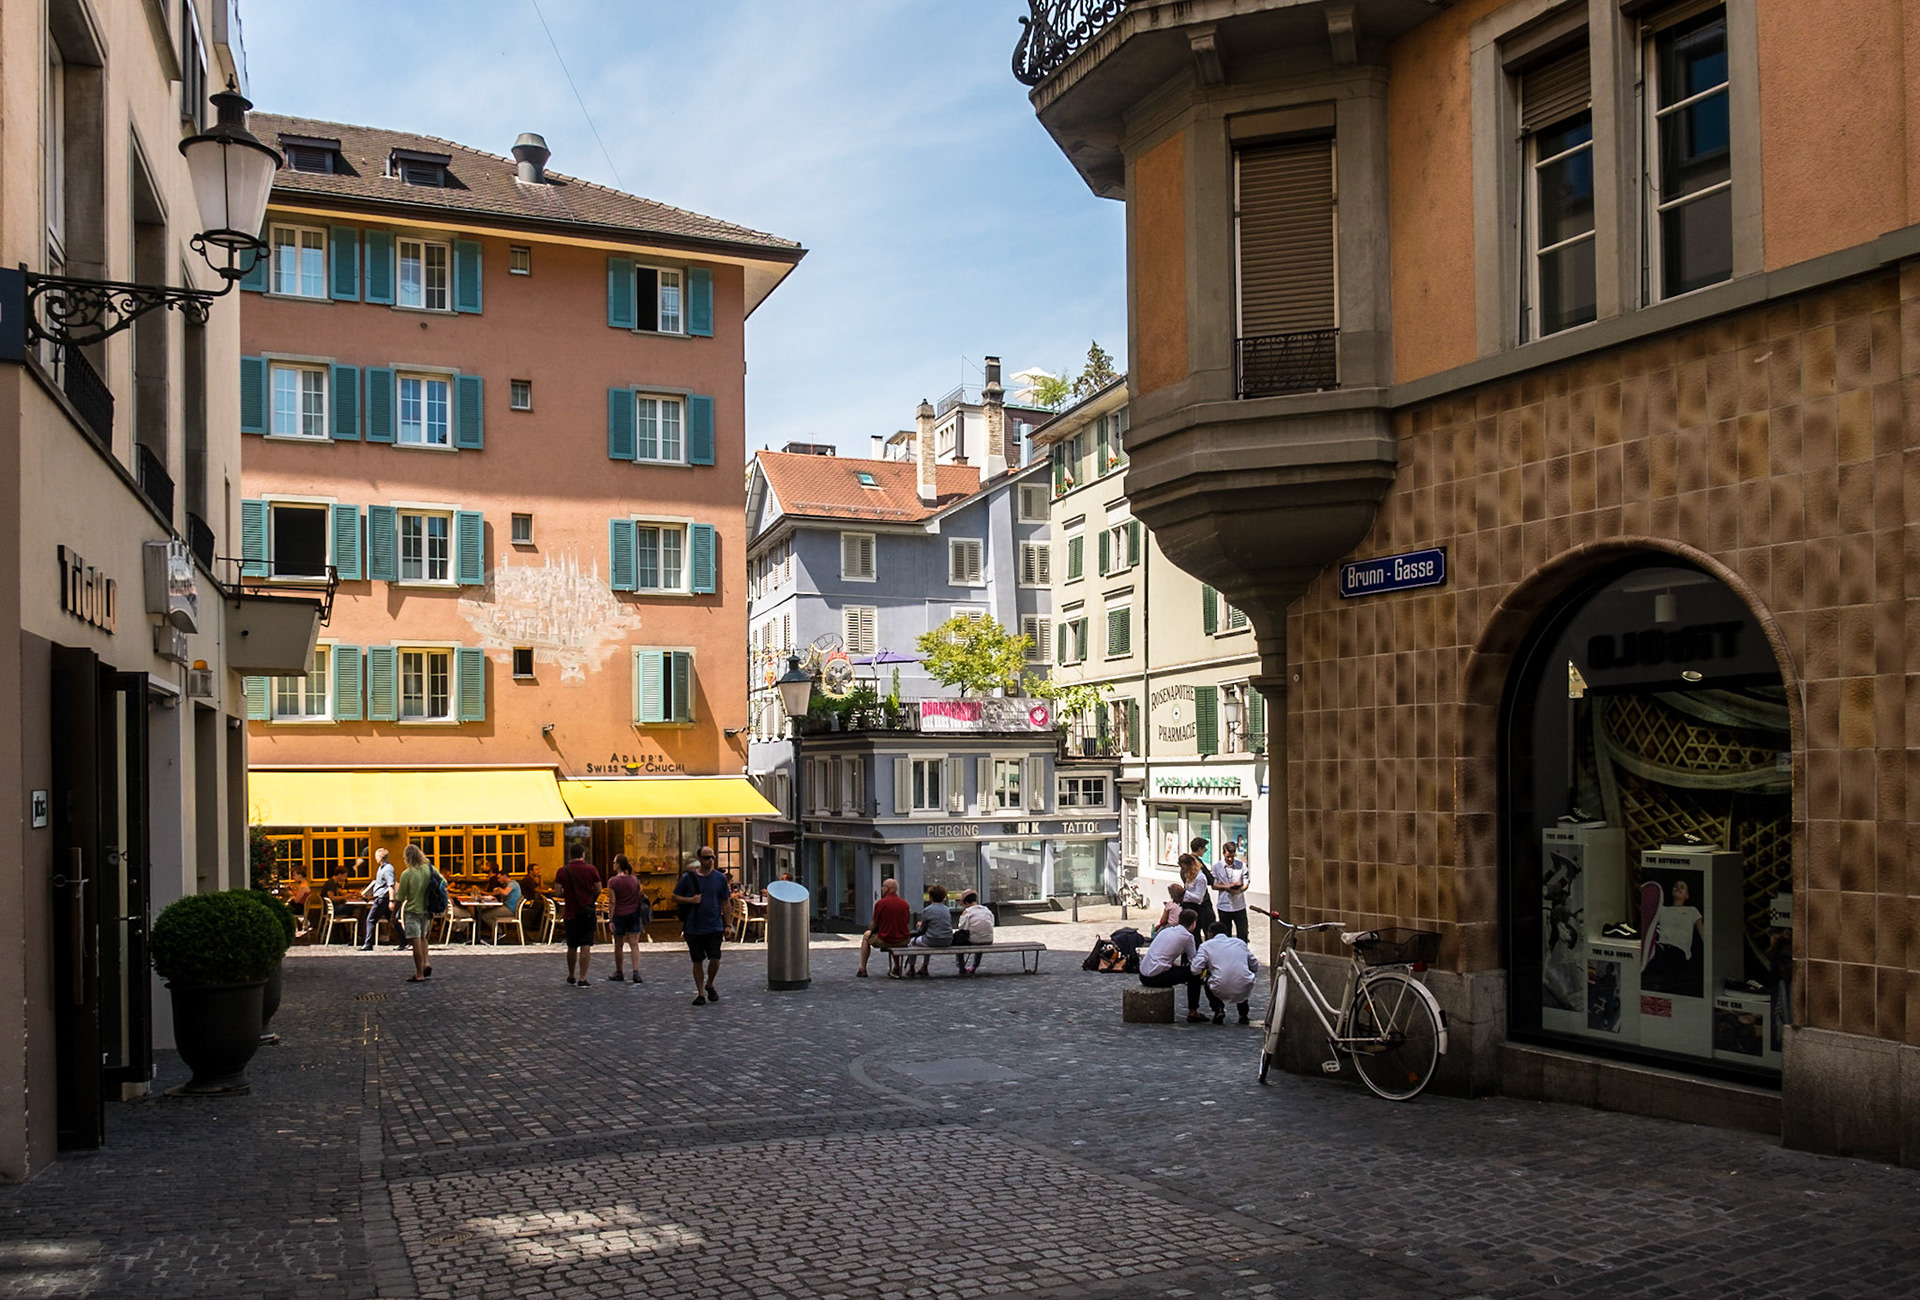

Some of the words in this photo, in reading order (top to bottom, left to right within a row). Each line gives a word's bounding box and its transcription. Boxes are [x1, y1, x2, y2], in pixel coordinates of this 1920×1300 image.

[1347, 566, 1384, 589] Brunn
[1394, 558, 1434, 582] Gasse
[1158, 721, 1196, 742] PHARMACIE
[610, 752, 663, 763] ADLER'S
[586, 763, 618, 773] SWISS
[645, 762, 684, 772] CHUCHI
[926, 824, 979, 837] PIERCING
[1061, 821, 1102, 834] TATTOO
[1717, 999, 1728, 1008] THE
